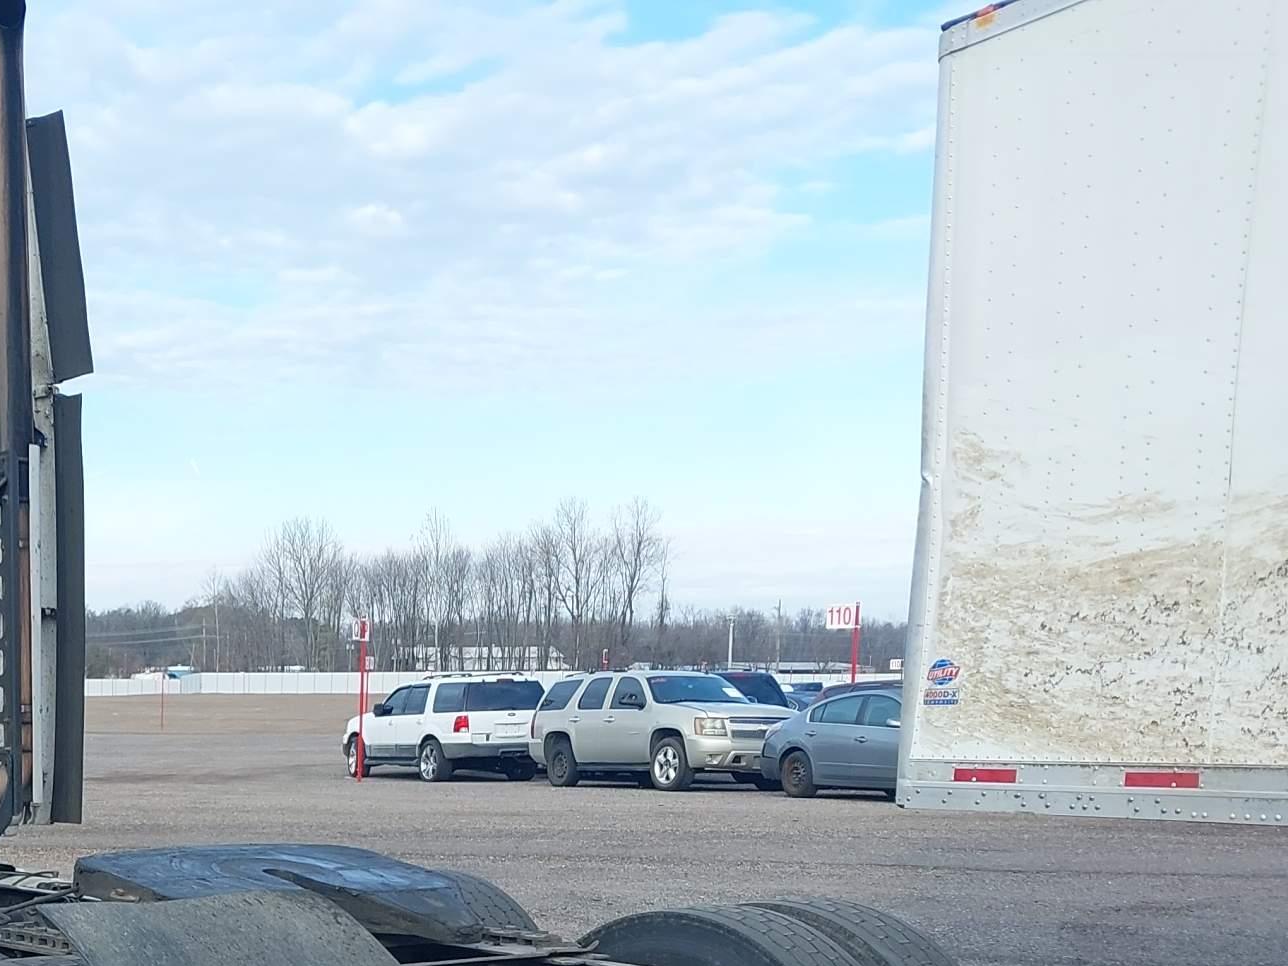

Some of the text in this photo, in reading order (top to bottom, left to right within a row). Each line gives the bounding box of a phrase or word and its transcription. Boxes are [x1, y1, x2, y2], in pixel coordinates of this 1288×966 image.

[828, 607, 852, 626] 110
[928, 666, 959, 680] UTILITY
[925, 690, 958, 699] 4000D-X
